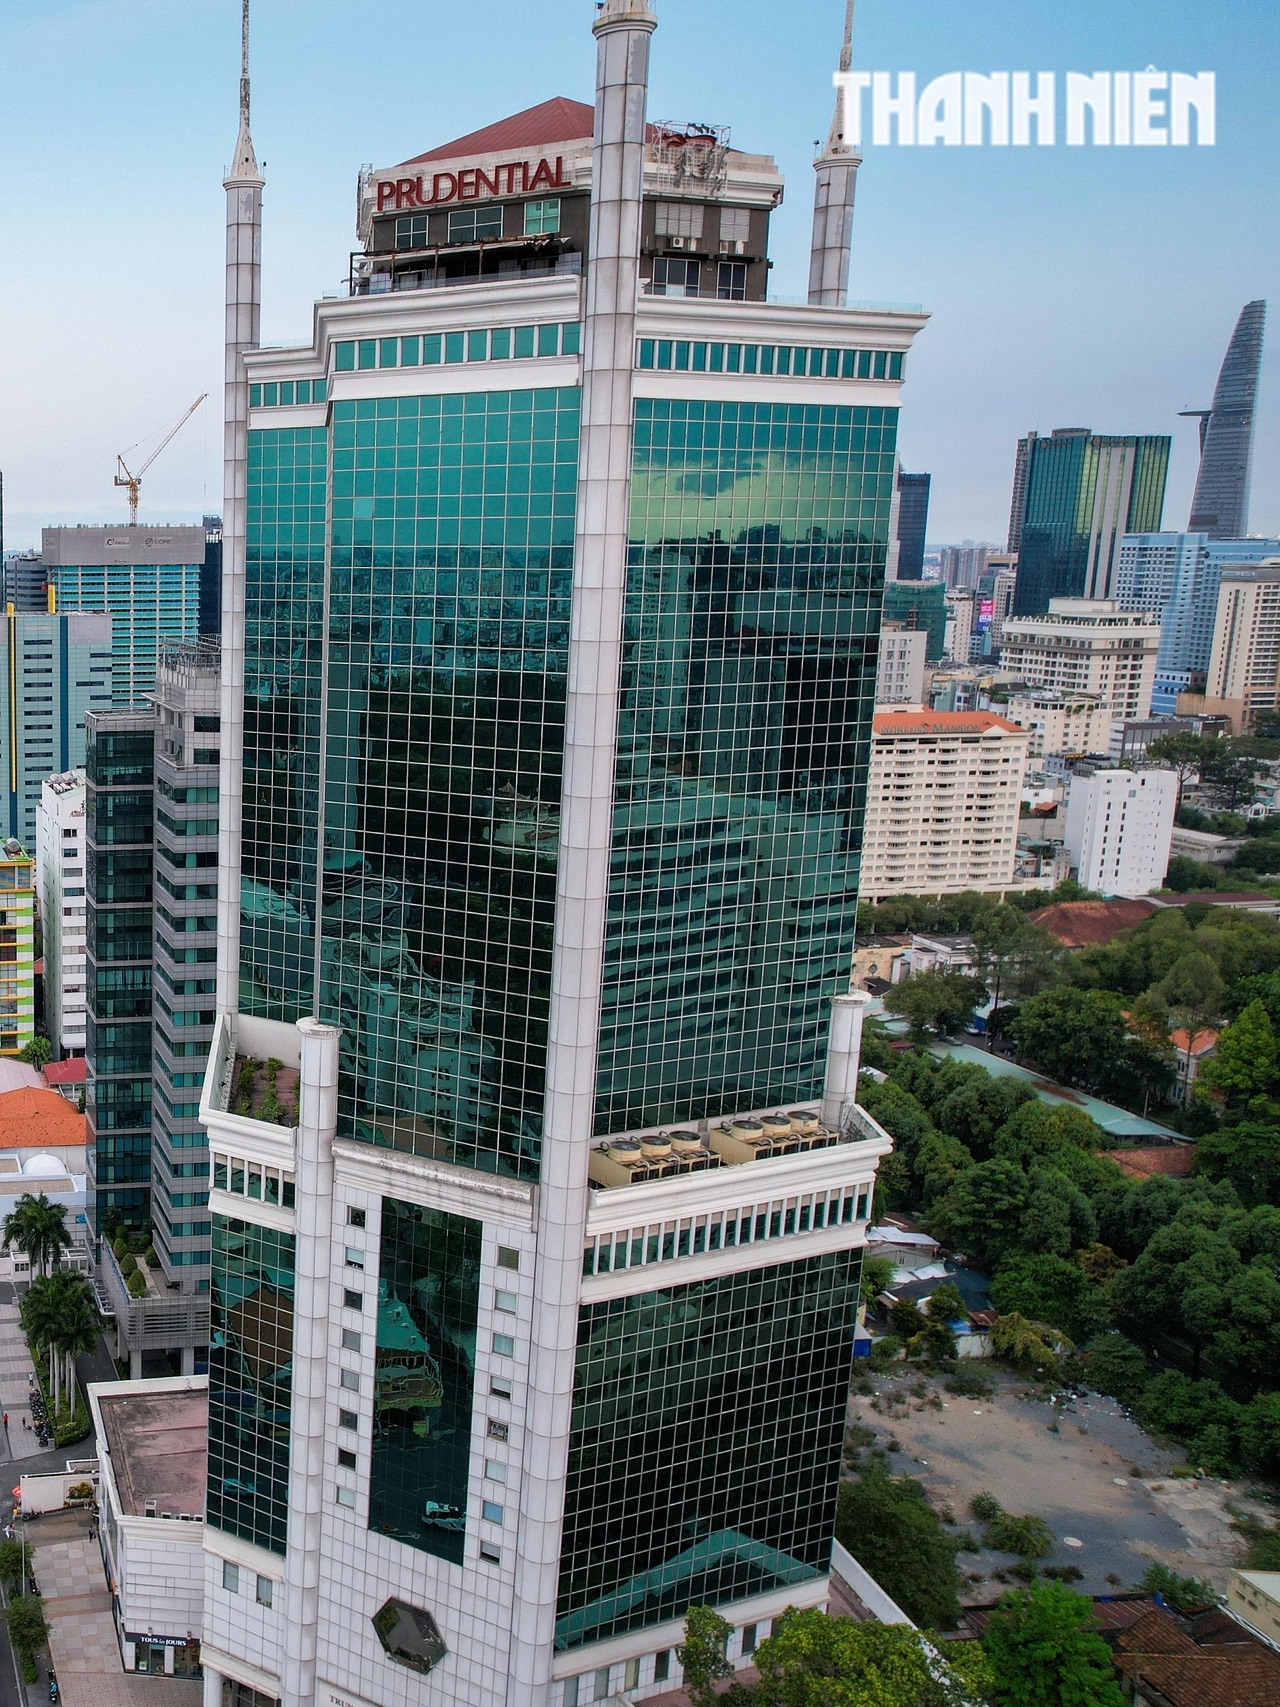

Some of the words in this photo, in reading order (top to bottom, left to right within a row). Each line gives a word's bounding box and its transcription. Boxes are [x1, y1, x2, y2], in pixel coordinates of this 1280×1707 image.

[377, 156, 572, 212] PRUDENTIAL
[879, 724, 927, 734] NORFOLK
[931, 723, 981, 733] MANSION
[140, 1636, 159, 1644] TOUS
